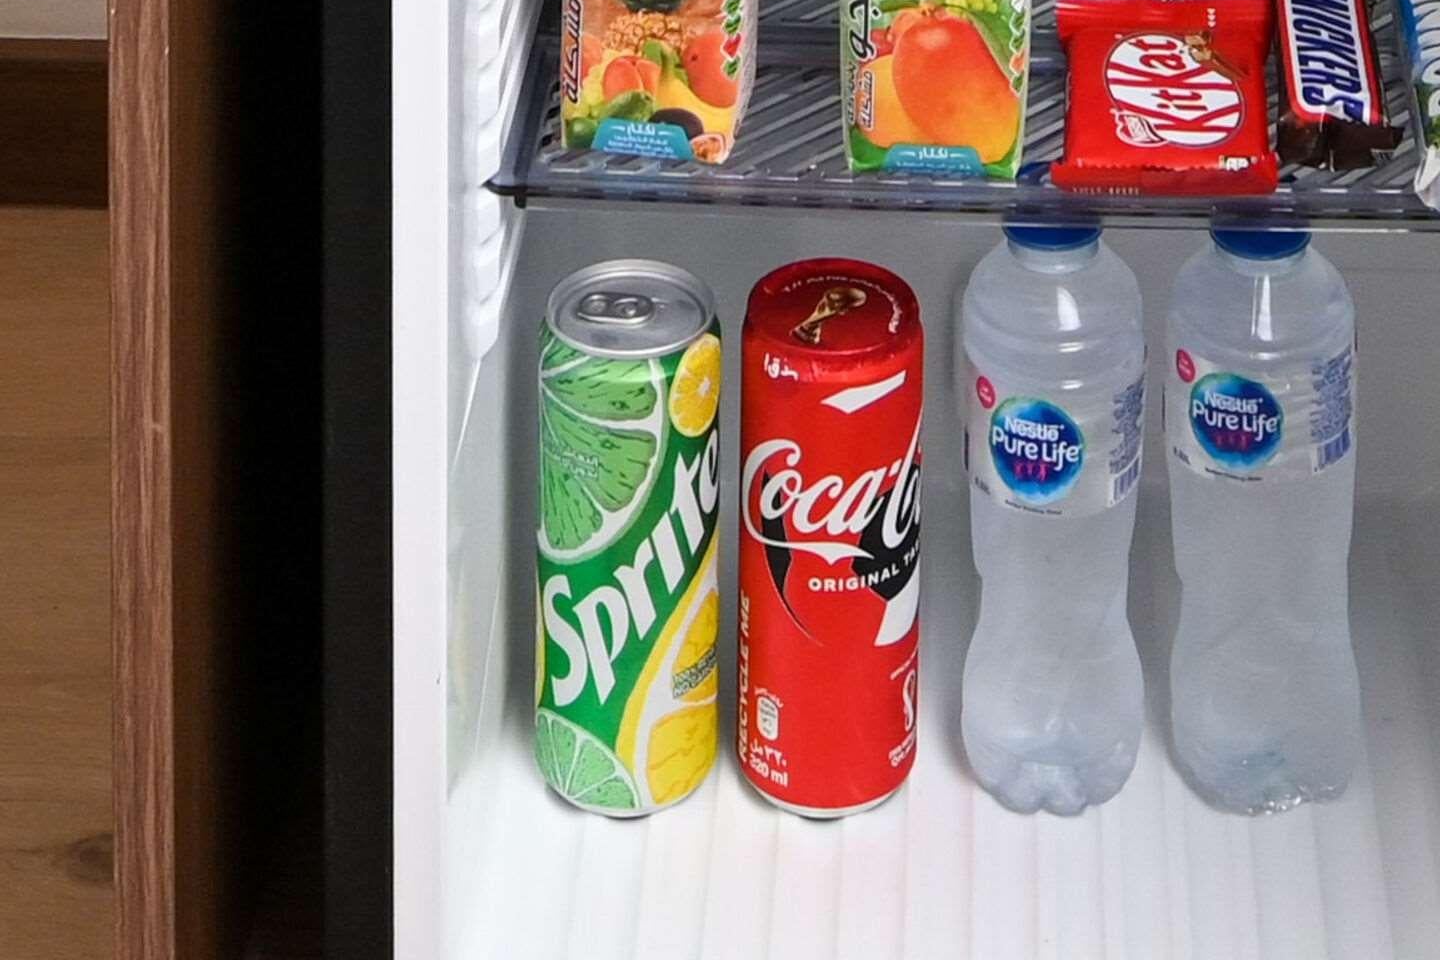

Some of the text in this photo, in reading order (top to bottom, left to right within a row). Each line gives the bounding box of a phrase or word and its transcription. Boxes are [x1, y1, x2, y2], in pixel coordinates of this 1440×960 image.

[1192, 398, 1279, 442] Pure Life
[991, 425, 1080, 471] Pure Life
[742, 425, 920, 564] Coca-C
[544, 428, 719, 707] Sprite
[808, 563, 900, 593] ORIGINAL
